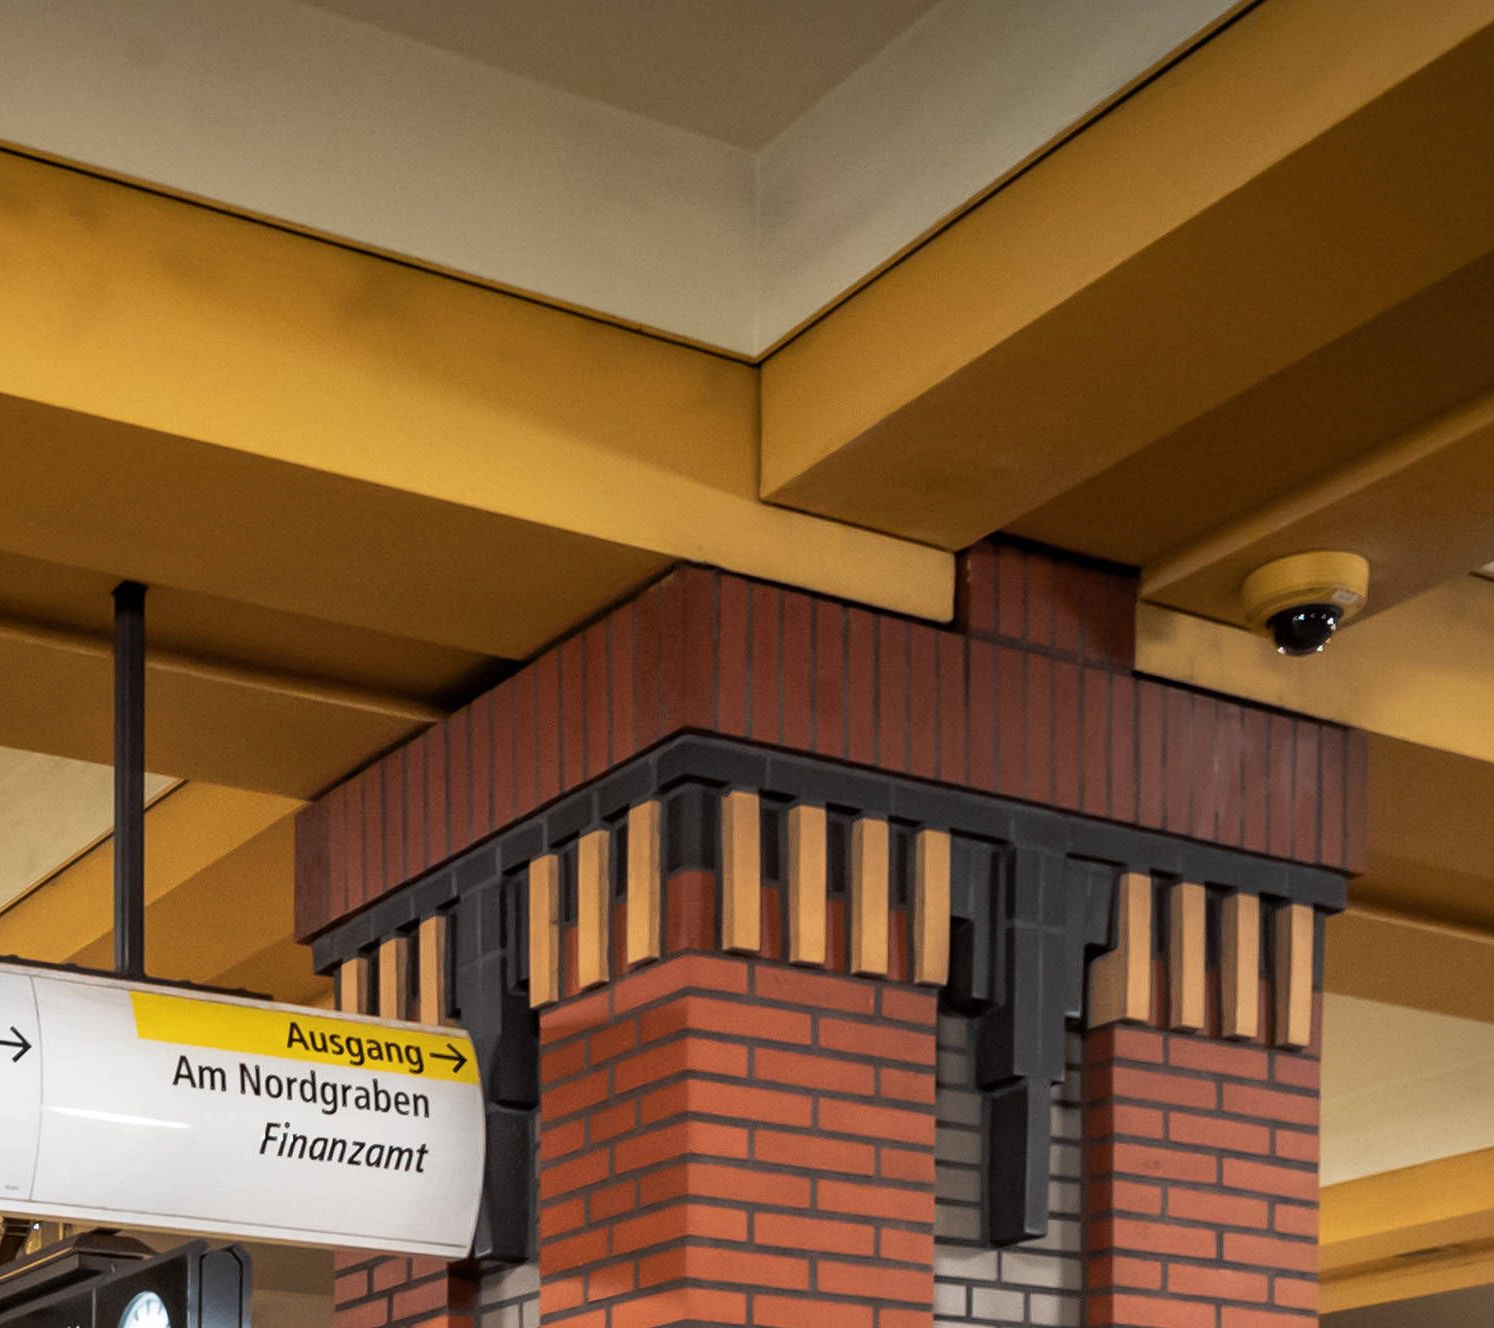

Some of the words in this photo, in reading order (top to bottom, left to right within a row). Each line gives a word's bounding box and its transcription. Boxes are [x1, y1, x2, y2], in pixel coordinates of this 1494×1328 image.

[286, 1021, 425, 1075] Ausgang
[172, 1054, 227, 1092] Am
[239, 1062, 431, 1118] Nordgraben
[259, 1121, 430, 1174] Finanzamt
